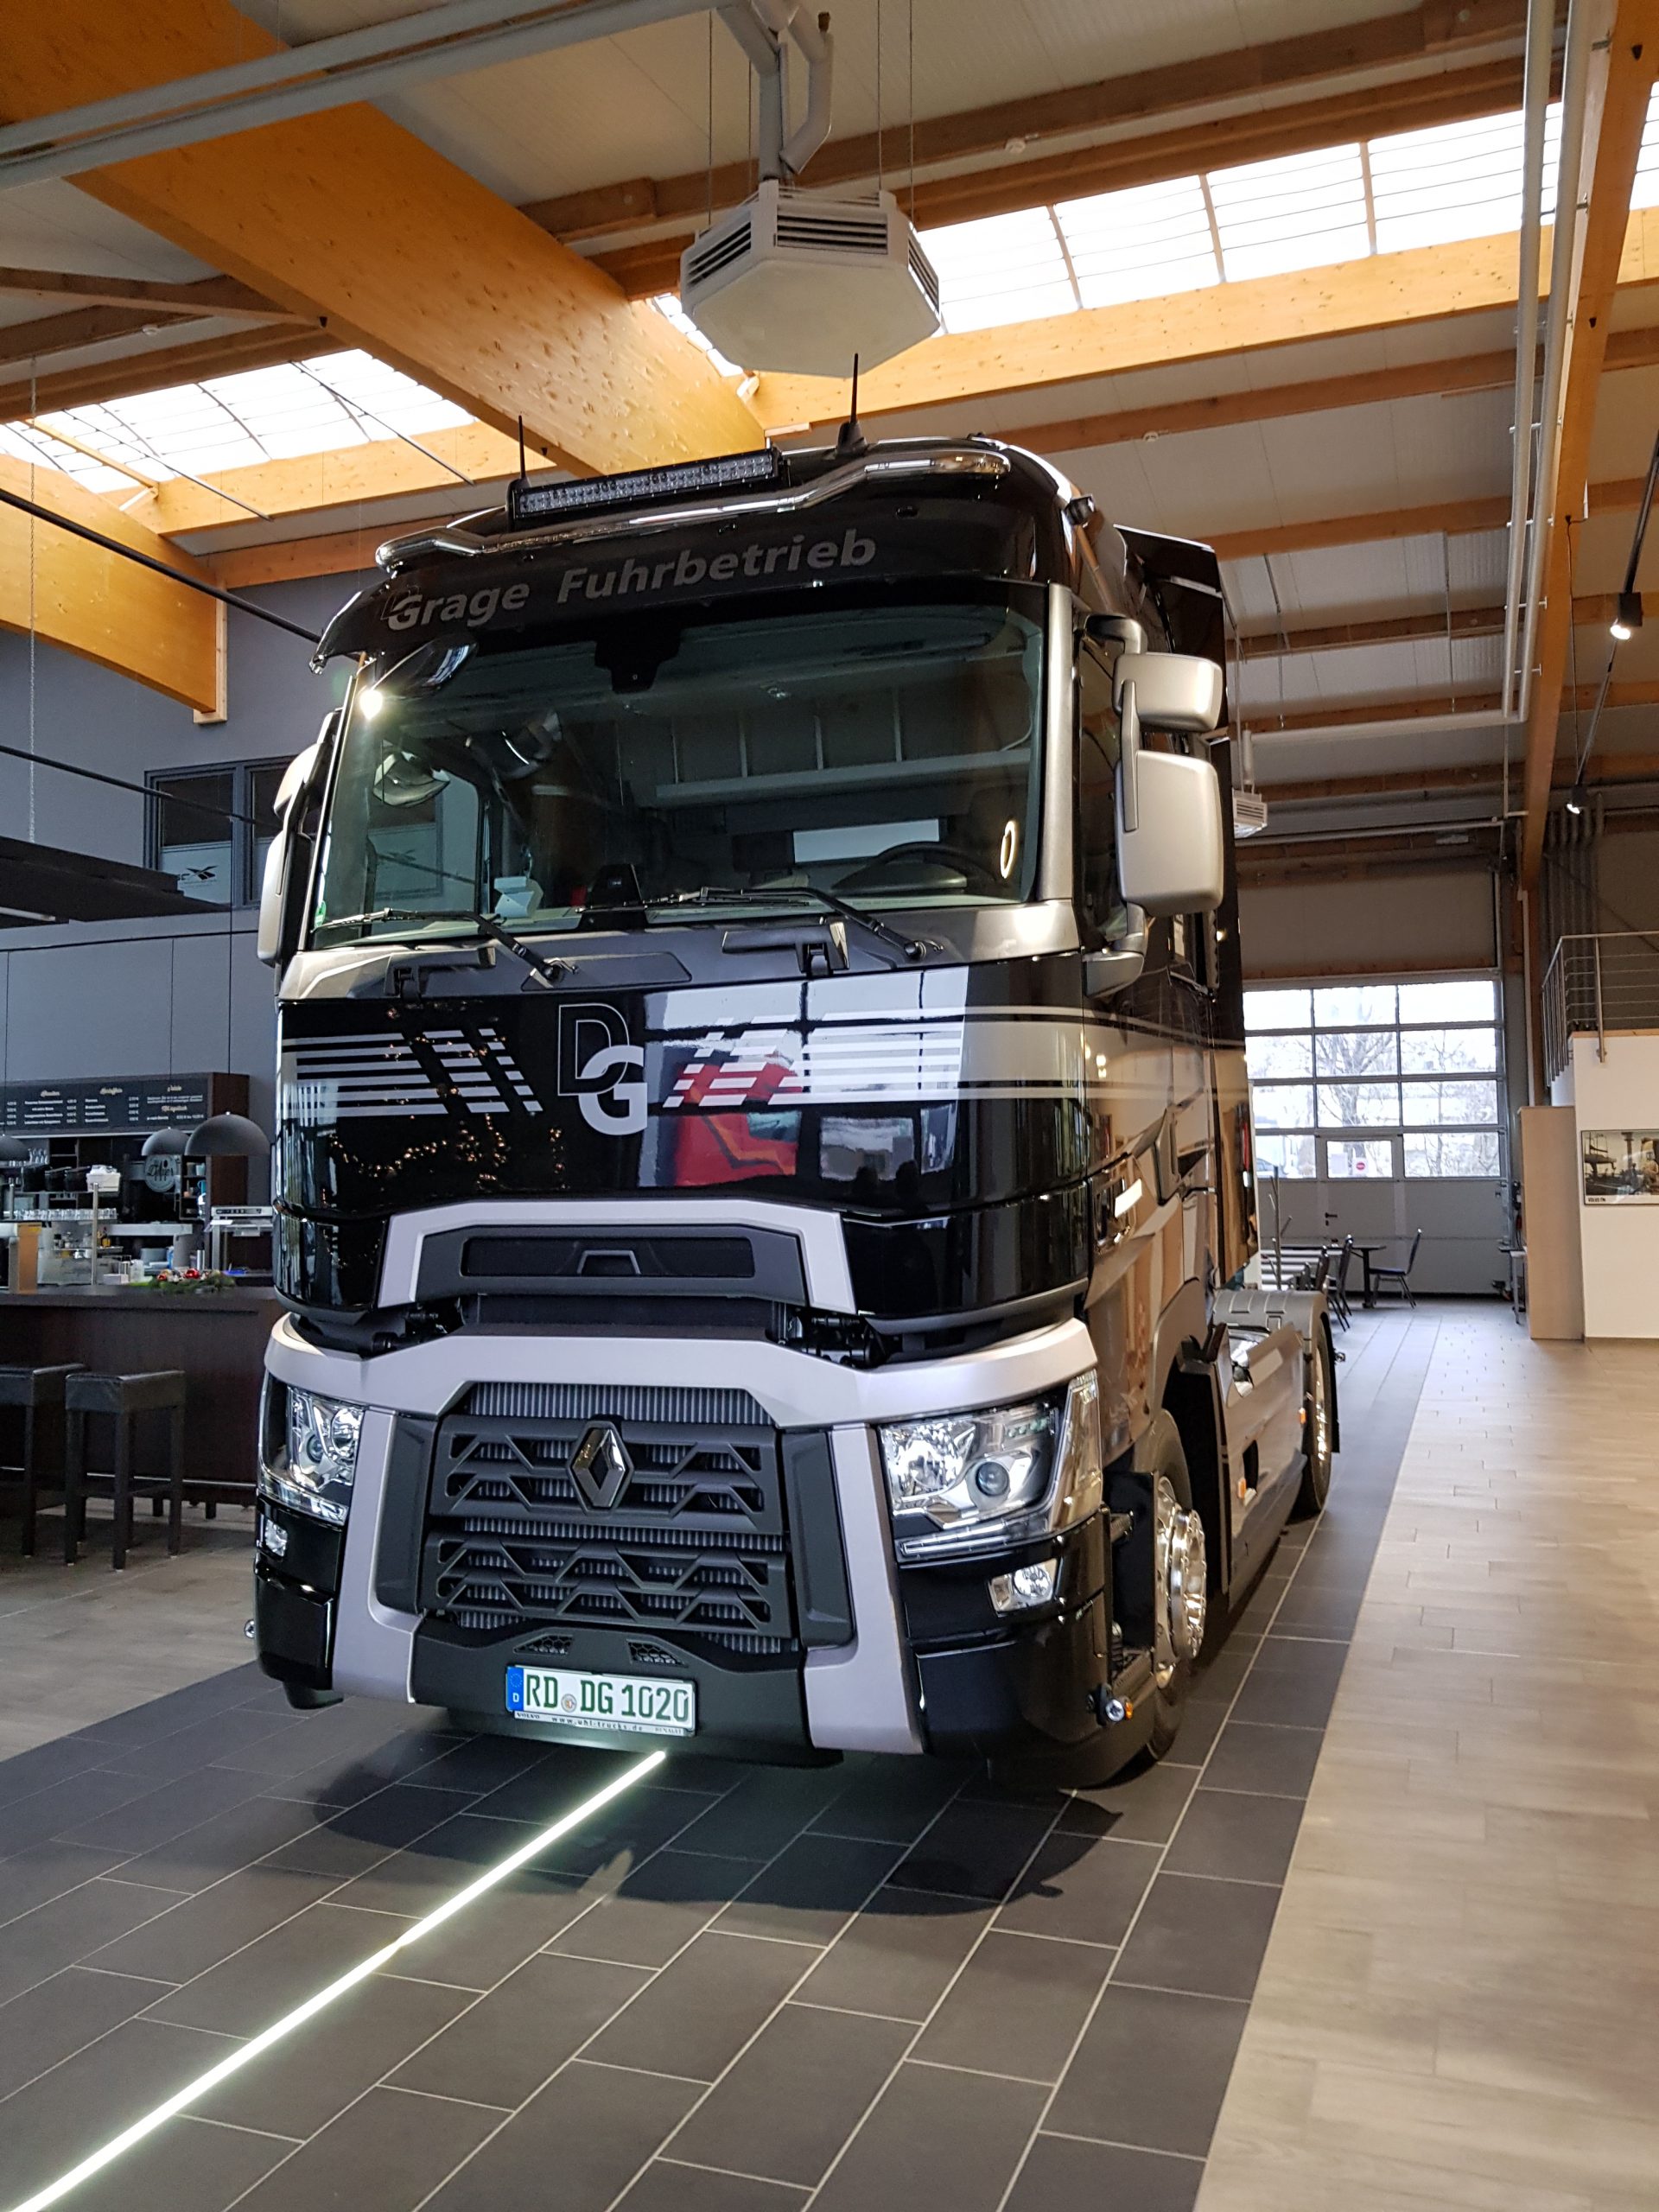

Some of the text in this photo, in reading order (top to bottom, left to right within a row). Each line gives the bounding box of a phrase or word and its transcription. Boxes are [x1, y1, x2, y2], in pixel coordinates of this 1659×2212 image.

[386, 528, 877, 632] Grage Fuhrbetrieb
[526, 1674, 690, 1723] RD DG 1020
[551, 1716, 644, 1732] www.uhl-trucks.de
